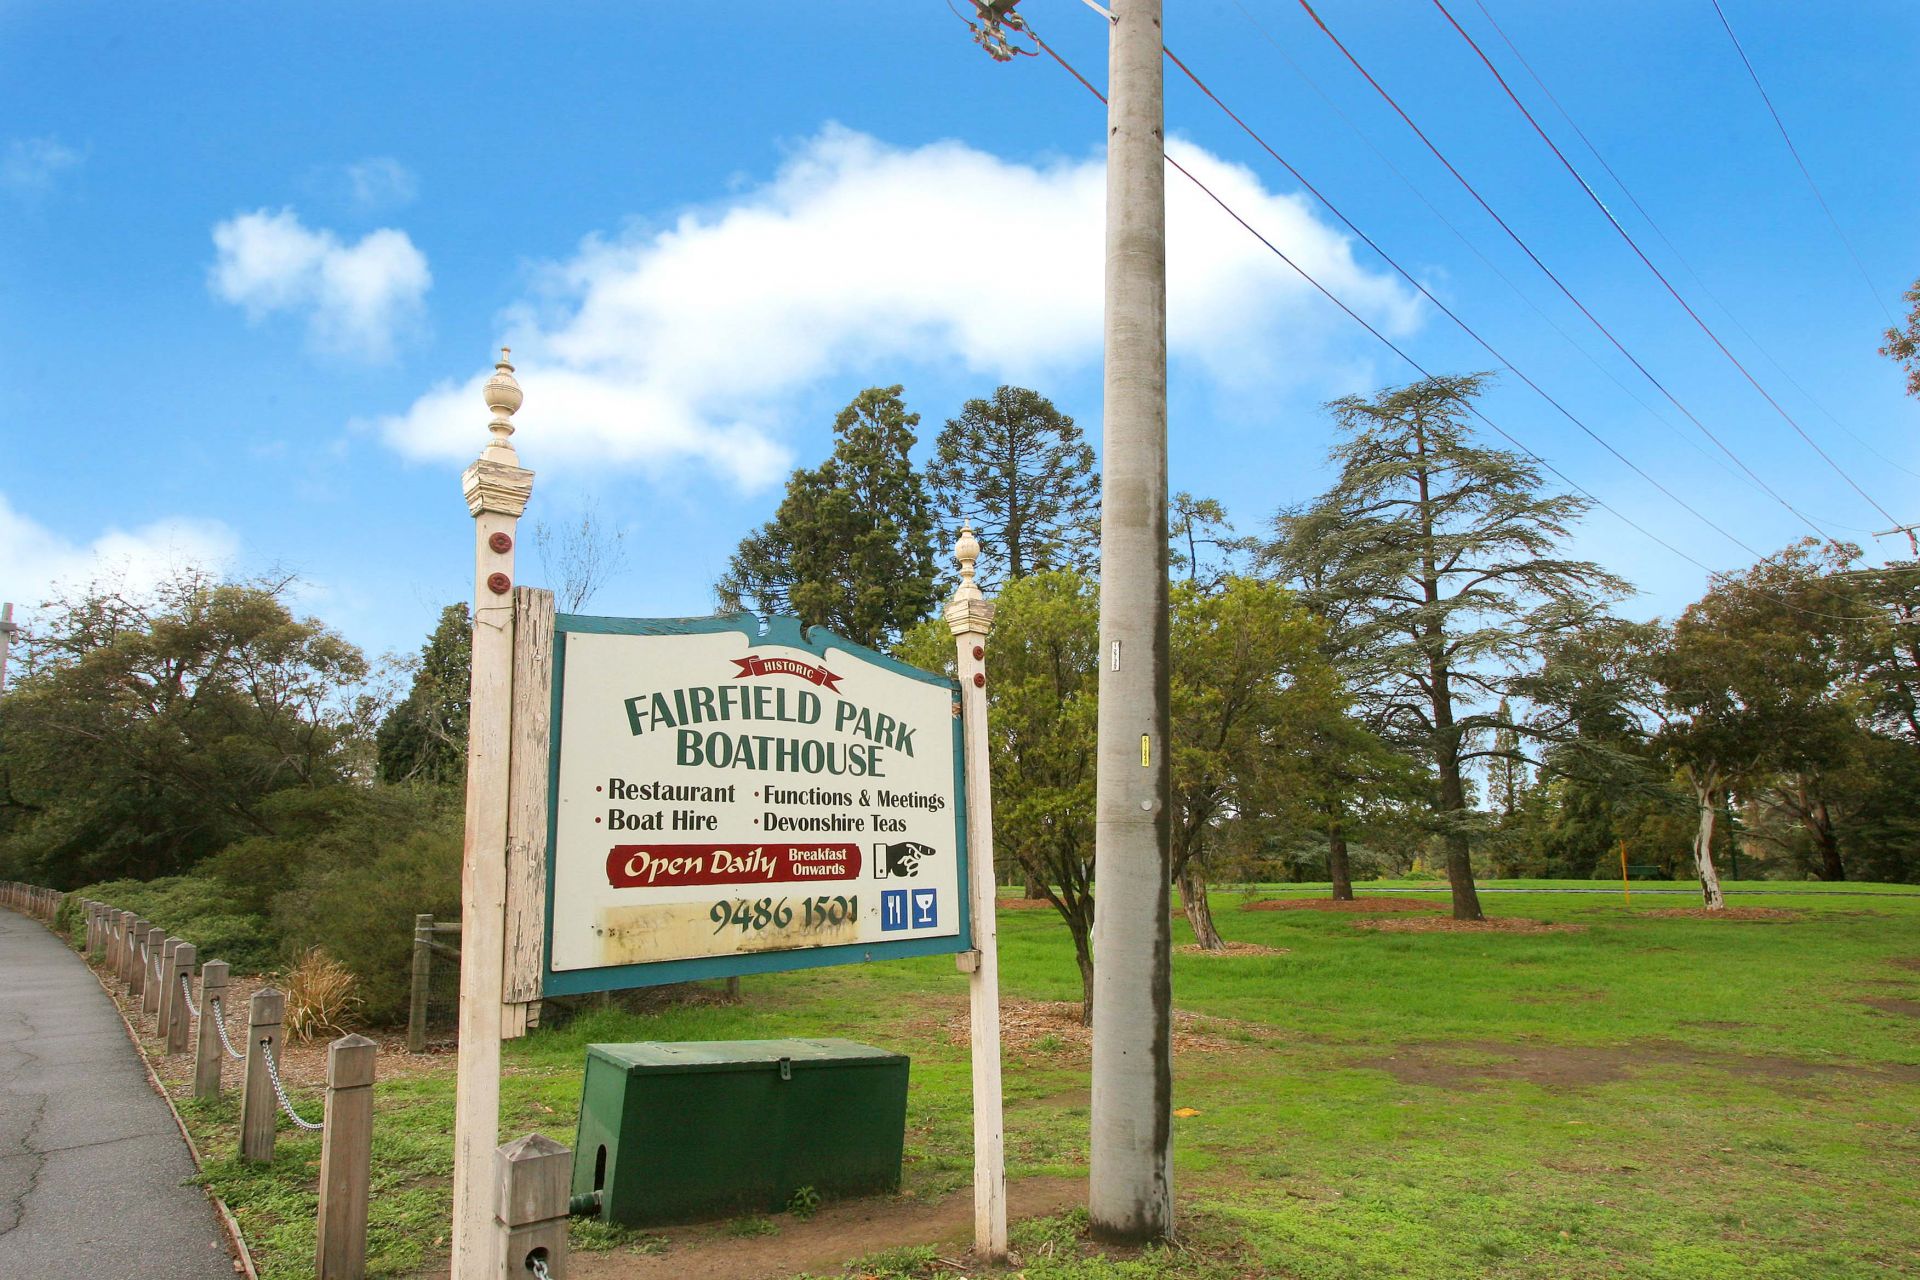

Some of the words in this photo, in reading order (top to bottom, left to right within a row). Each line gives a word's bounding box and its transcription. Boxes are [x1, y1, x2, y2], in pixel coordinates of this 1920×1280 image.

[763, 660, 814, 679] HISTORIC
[624, 685, 821, 736] FAIRFIELD
[835, 700, 917, 758] PARK
[676, 729, 885, 777] BOATHOUSE
[609, 778, 735, 803] Restaurant
[764, 785, 852, 807] Functions
[859, 790, 871, 807] &
[877, 790, 945, 812] Meetings
[608, 809, 663, 831] Boat
[672, 809, 718, 831] Hire
[764, 812, 864, 832] Devonshire
[870, 814, 906, 833] Teas
[624, 851, 703, 883] Open
[711, 847, 777, 878] Daily
[788, 848, 846, 861] Breakfast
[792, 862, 846, 876] Onwards
[709, 896, 792, 936] 9486
[802, 895, 858, 929] 1501
